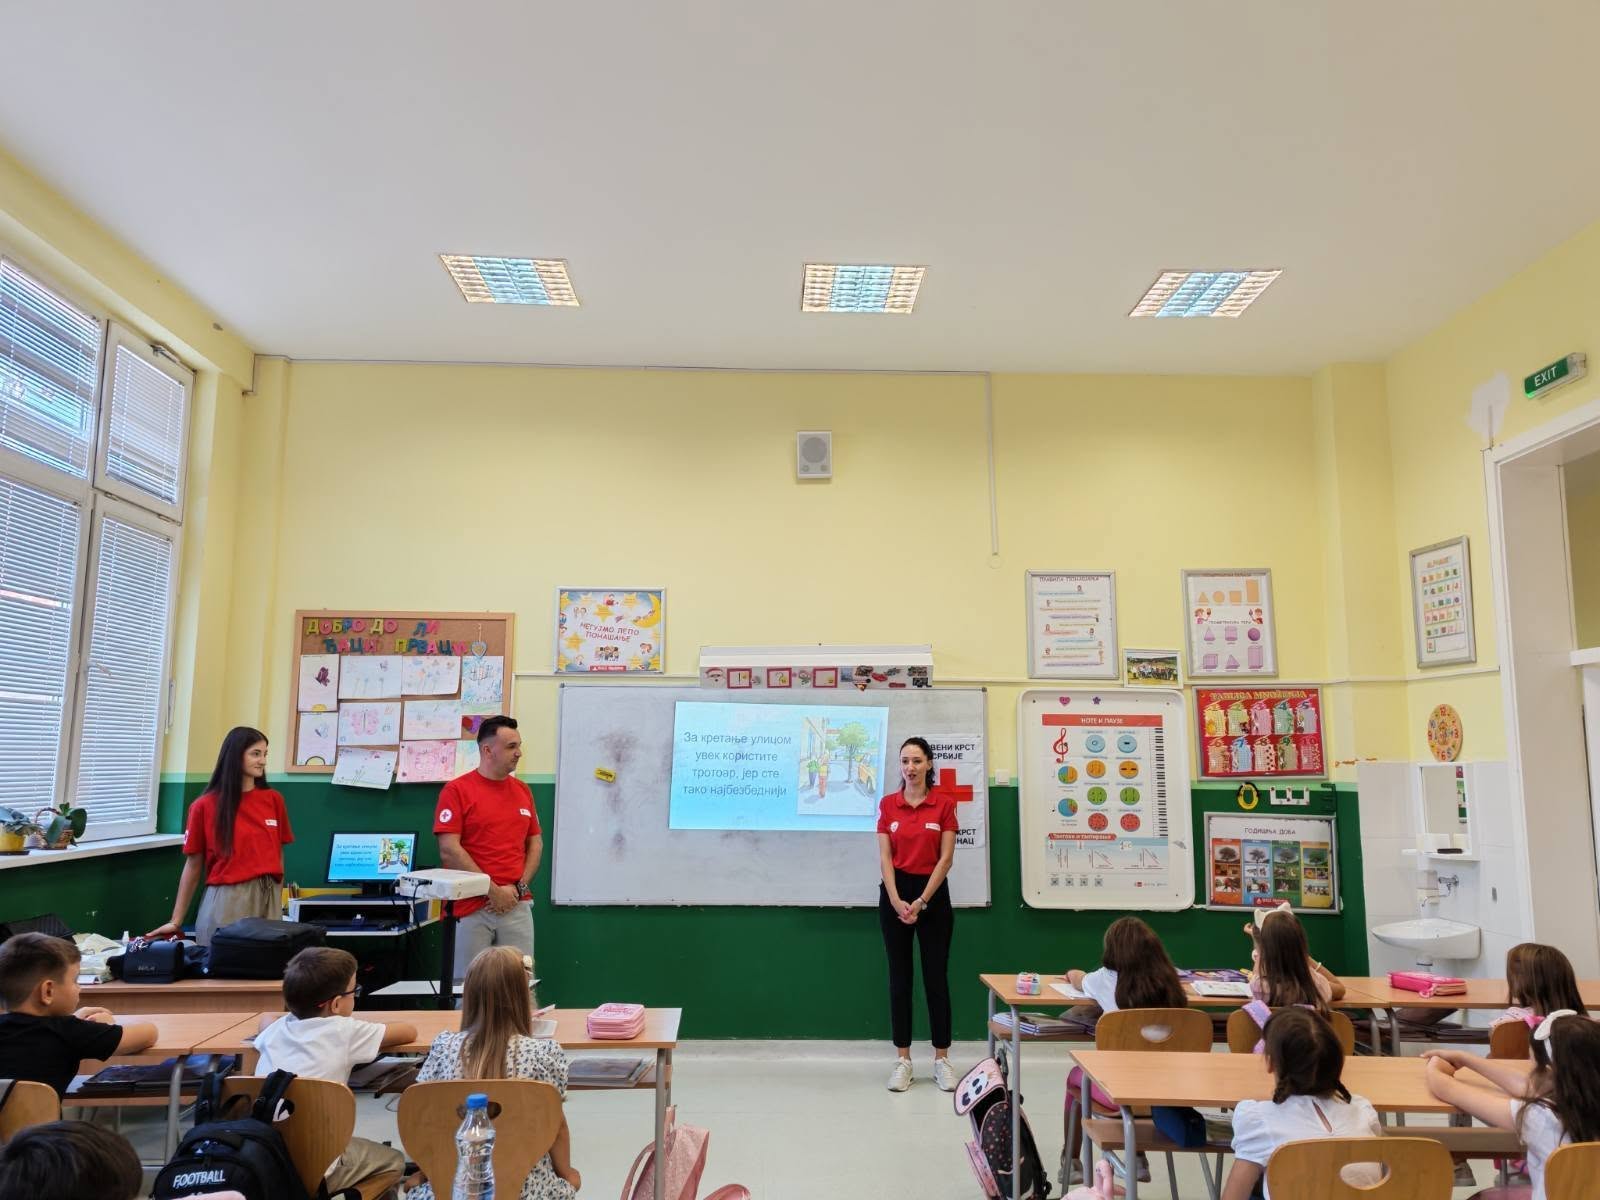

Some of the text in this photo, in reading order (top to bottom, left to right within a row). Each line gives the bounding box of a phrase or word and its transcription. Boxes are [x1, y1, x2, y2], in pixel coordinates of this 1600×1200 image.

[1534, 366, 1557, 387] EXIT
[306, 618, 367, 635] ДОБРО
[580, 622, 640, 636] НЕГУЈМО ЛЕПО
[585, 631, 631, 643] ПОНАШАЊЕ
[1279, 701, 1288, 710] 4
[1302, 701, 1310, 710] 5
[683, 731, 792, 746] За кретање улицом
[695, 752, 778, 763] увек користите
[692, 768, 779, 780] тротоар, јер сте
[683, 785, 787, 798] тако најбезбеднији
[956, 837, 974, 846] НАЦ
[173, 1169, 226, 1188] FOOTBALL
